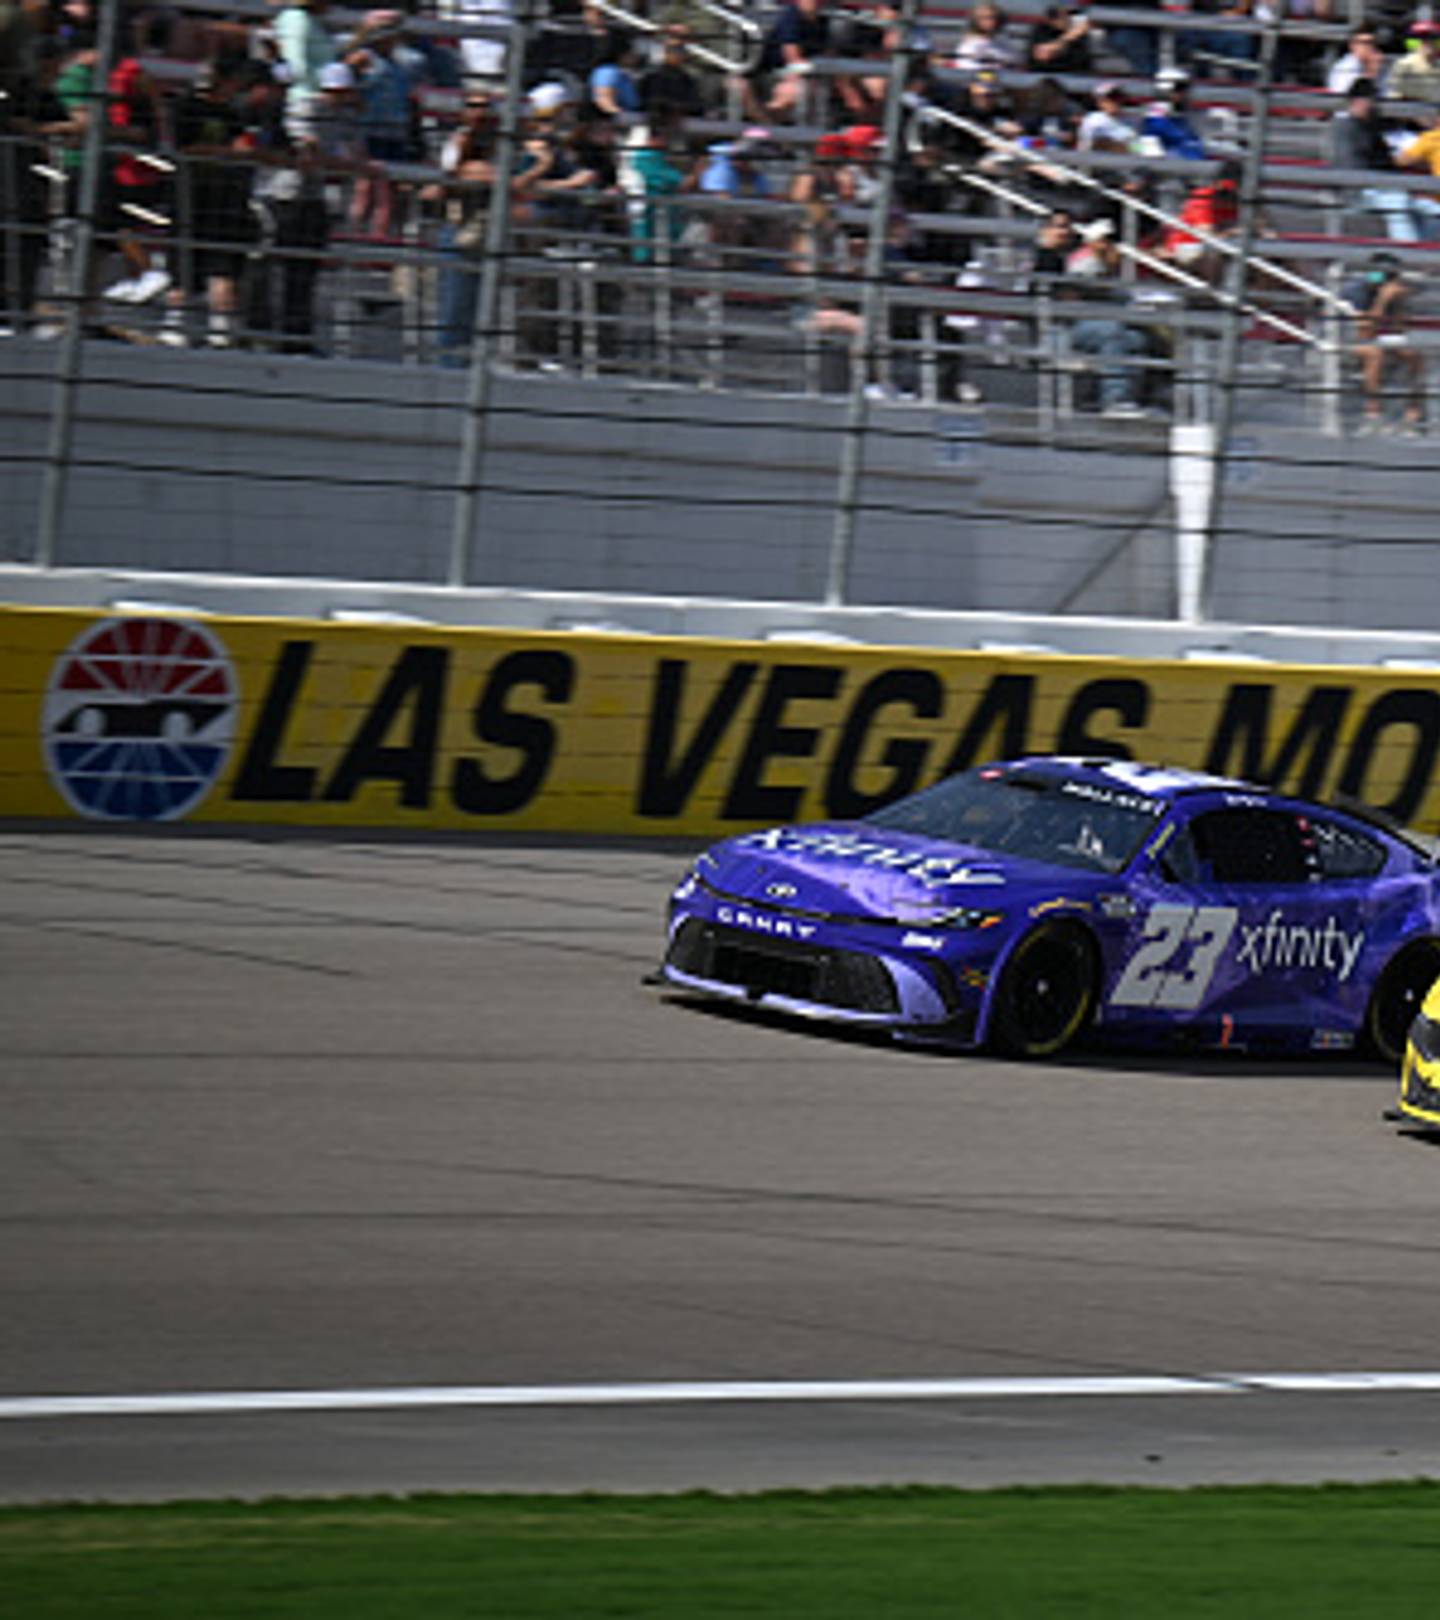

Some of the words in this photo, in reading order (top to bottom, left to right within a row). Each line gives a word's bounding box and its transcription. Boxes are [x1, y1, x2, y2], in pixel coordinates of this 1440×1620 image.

[231, 640, 578, 816] LAS
[634, 657, 1150, 822] VEGAS
[1109, 902, 1239, 1011] 23
[1235, 909, 1364, 982] xfinity
